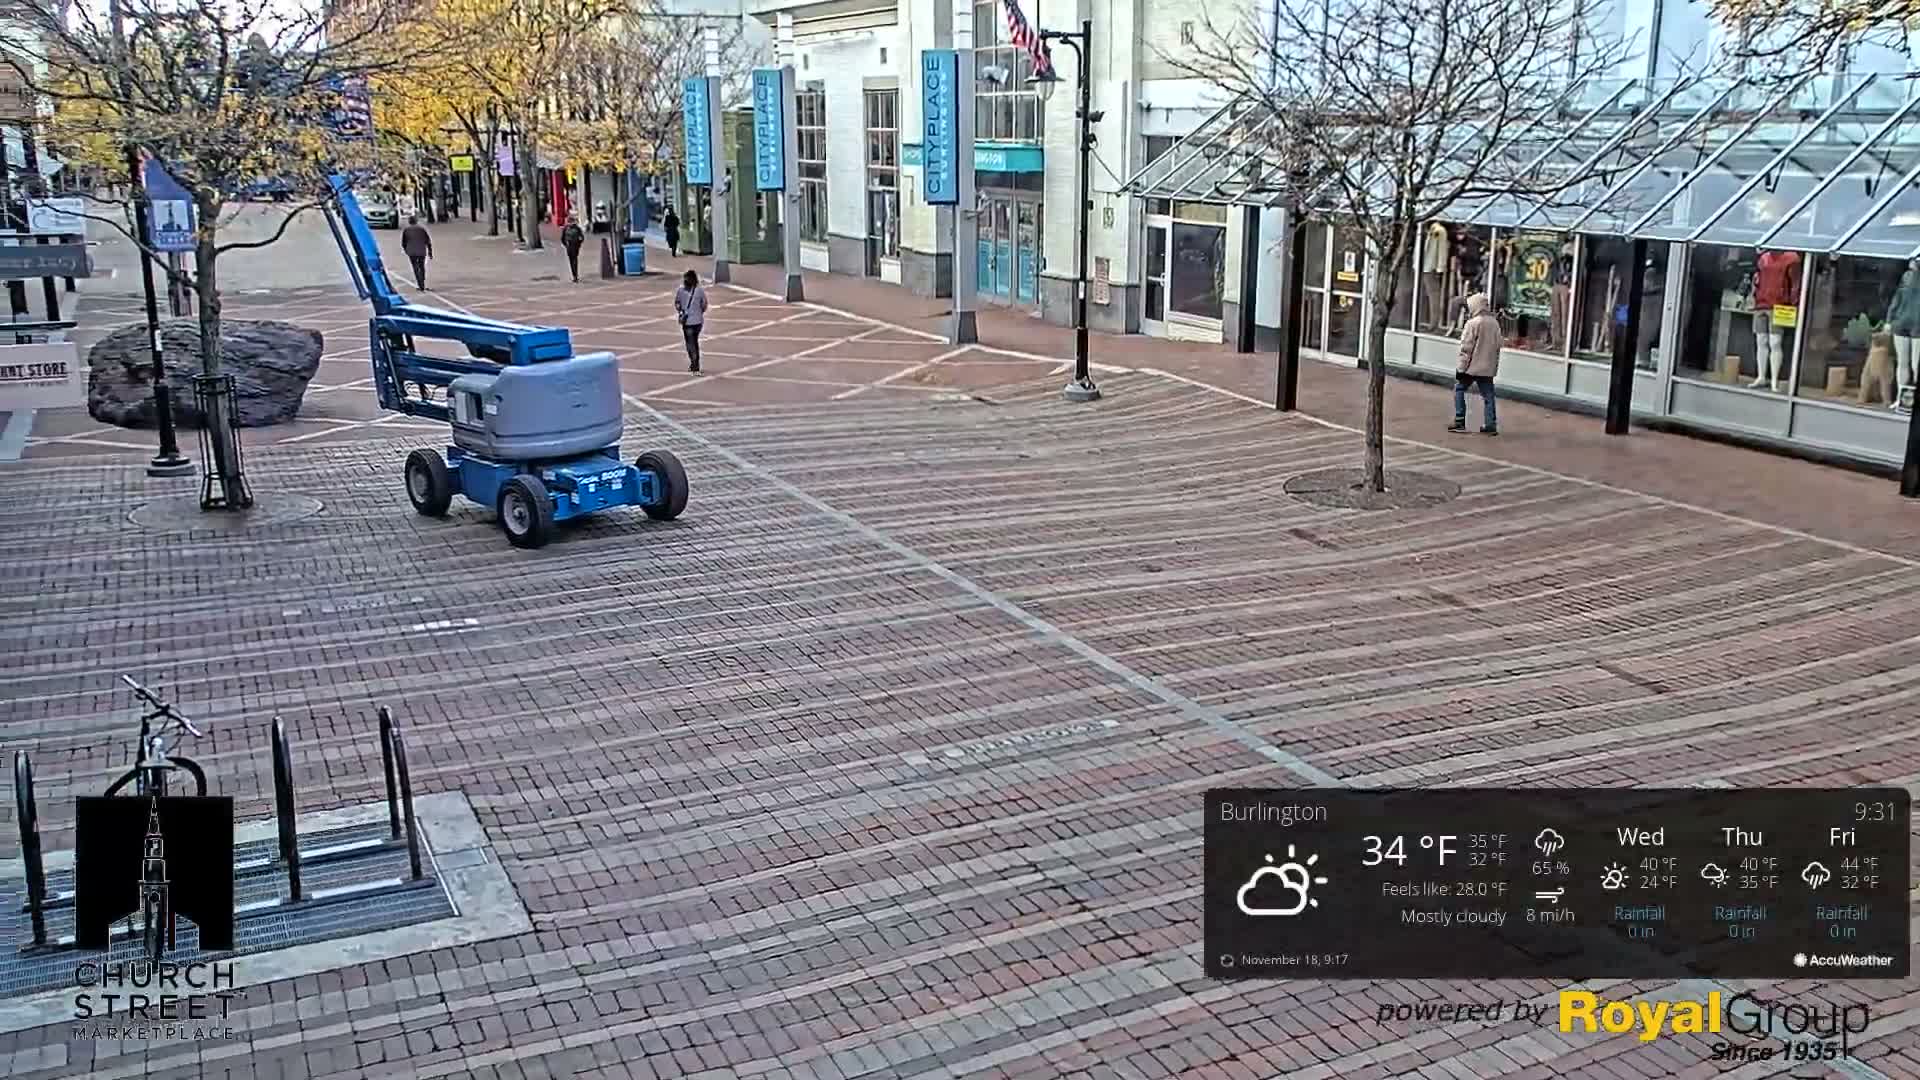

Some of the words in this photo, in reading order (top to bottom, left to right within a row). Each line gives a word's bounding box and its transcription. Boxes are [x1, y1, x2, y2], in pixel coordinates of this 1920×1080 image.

[685, 82, 700, 178] CITYPLACE
[757, 75, 770, 182] CITYPLACE
[928, 56, 940, 194] CITYPLACE
